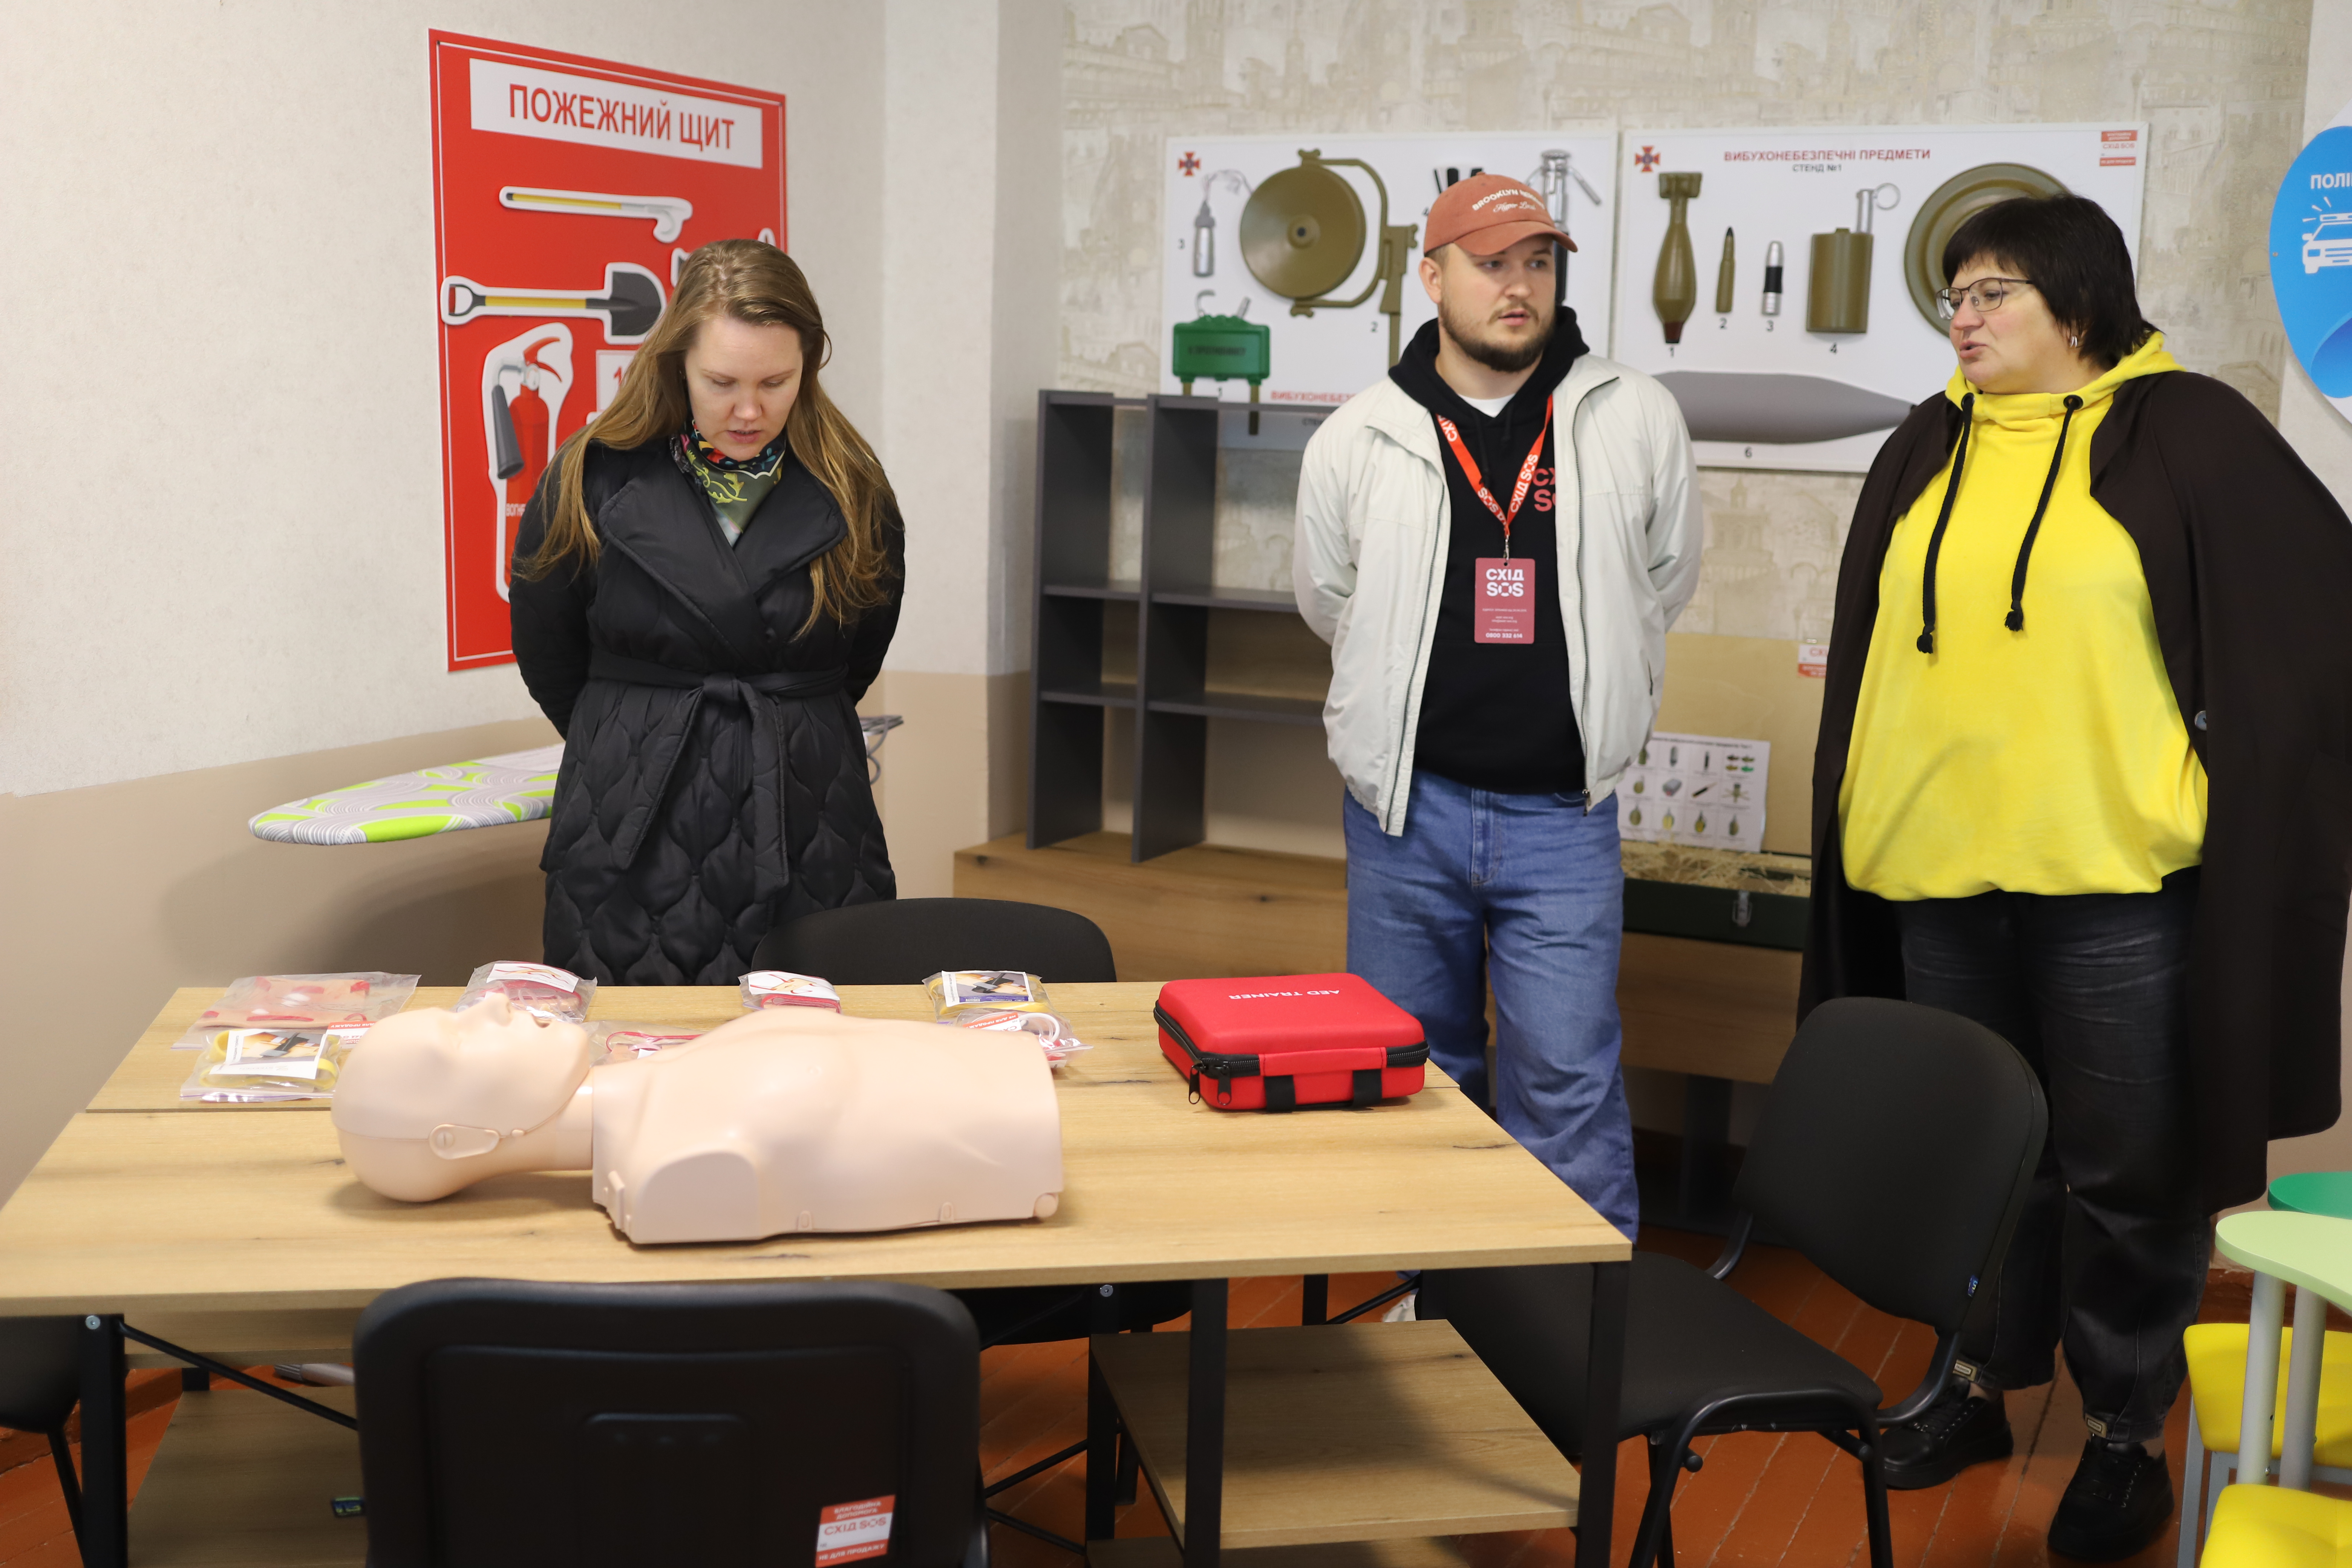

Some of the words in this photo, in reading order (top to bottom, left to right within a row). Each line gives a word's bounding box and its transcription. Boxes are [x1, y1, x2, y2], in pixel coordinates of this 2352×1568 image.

[510, 83, 671, 141] ПОЖЕЖНИЙ
[680, 110, 735, 152] ЩИТ
[1724, 150, 1856, 162] ВИБУХОНЕБЕЗПЕЧНІ
[1859, 149, 1931, 160] ПРЕДМЕТИ
[1792, 164, 1824, 173] СТЕНД
[2311, 172, 2352, 189] ПОЛІ
[1472, 189, 1519, 211] BROOKLYN
[1720, 318, 1727, 329] 2
[1766, 320, 1773, 332] 3
[1668, 347, 1674, 358] 1
[1829, 343, 1838, 354] 4
[1745, 447, 1752, 459] 6
[1510, 481, 1529, 513] СХІД
[1521, 453, 1538, 481] SOS
[1485, 568, 1524, 581] СХІД
[1486, 582, 1524, 597] SOS
[1229, 991, 1303, 1000] TRAINER
[824, 1522, 857, 1535] СХІД
[859, 1516, 886, 1530] SOS
[819, 1553, 828, 1561] НЕ
[830, 1551, 845, 1560] ДЛЯ
[847, 1544, 884, 1556] ПРОДАЖУ
